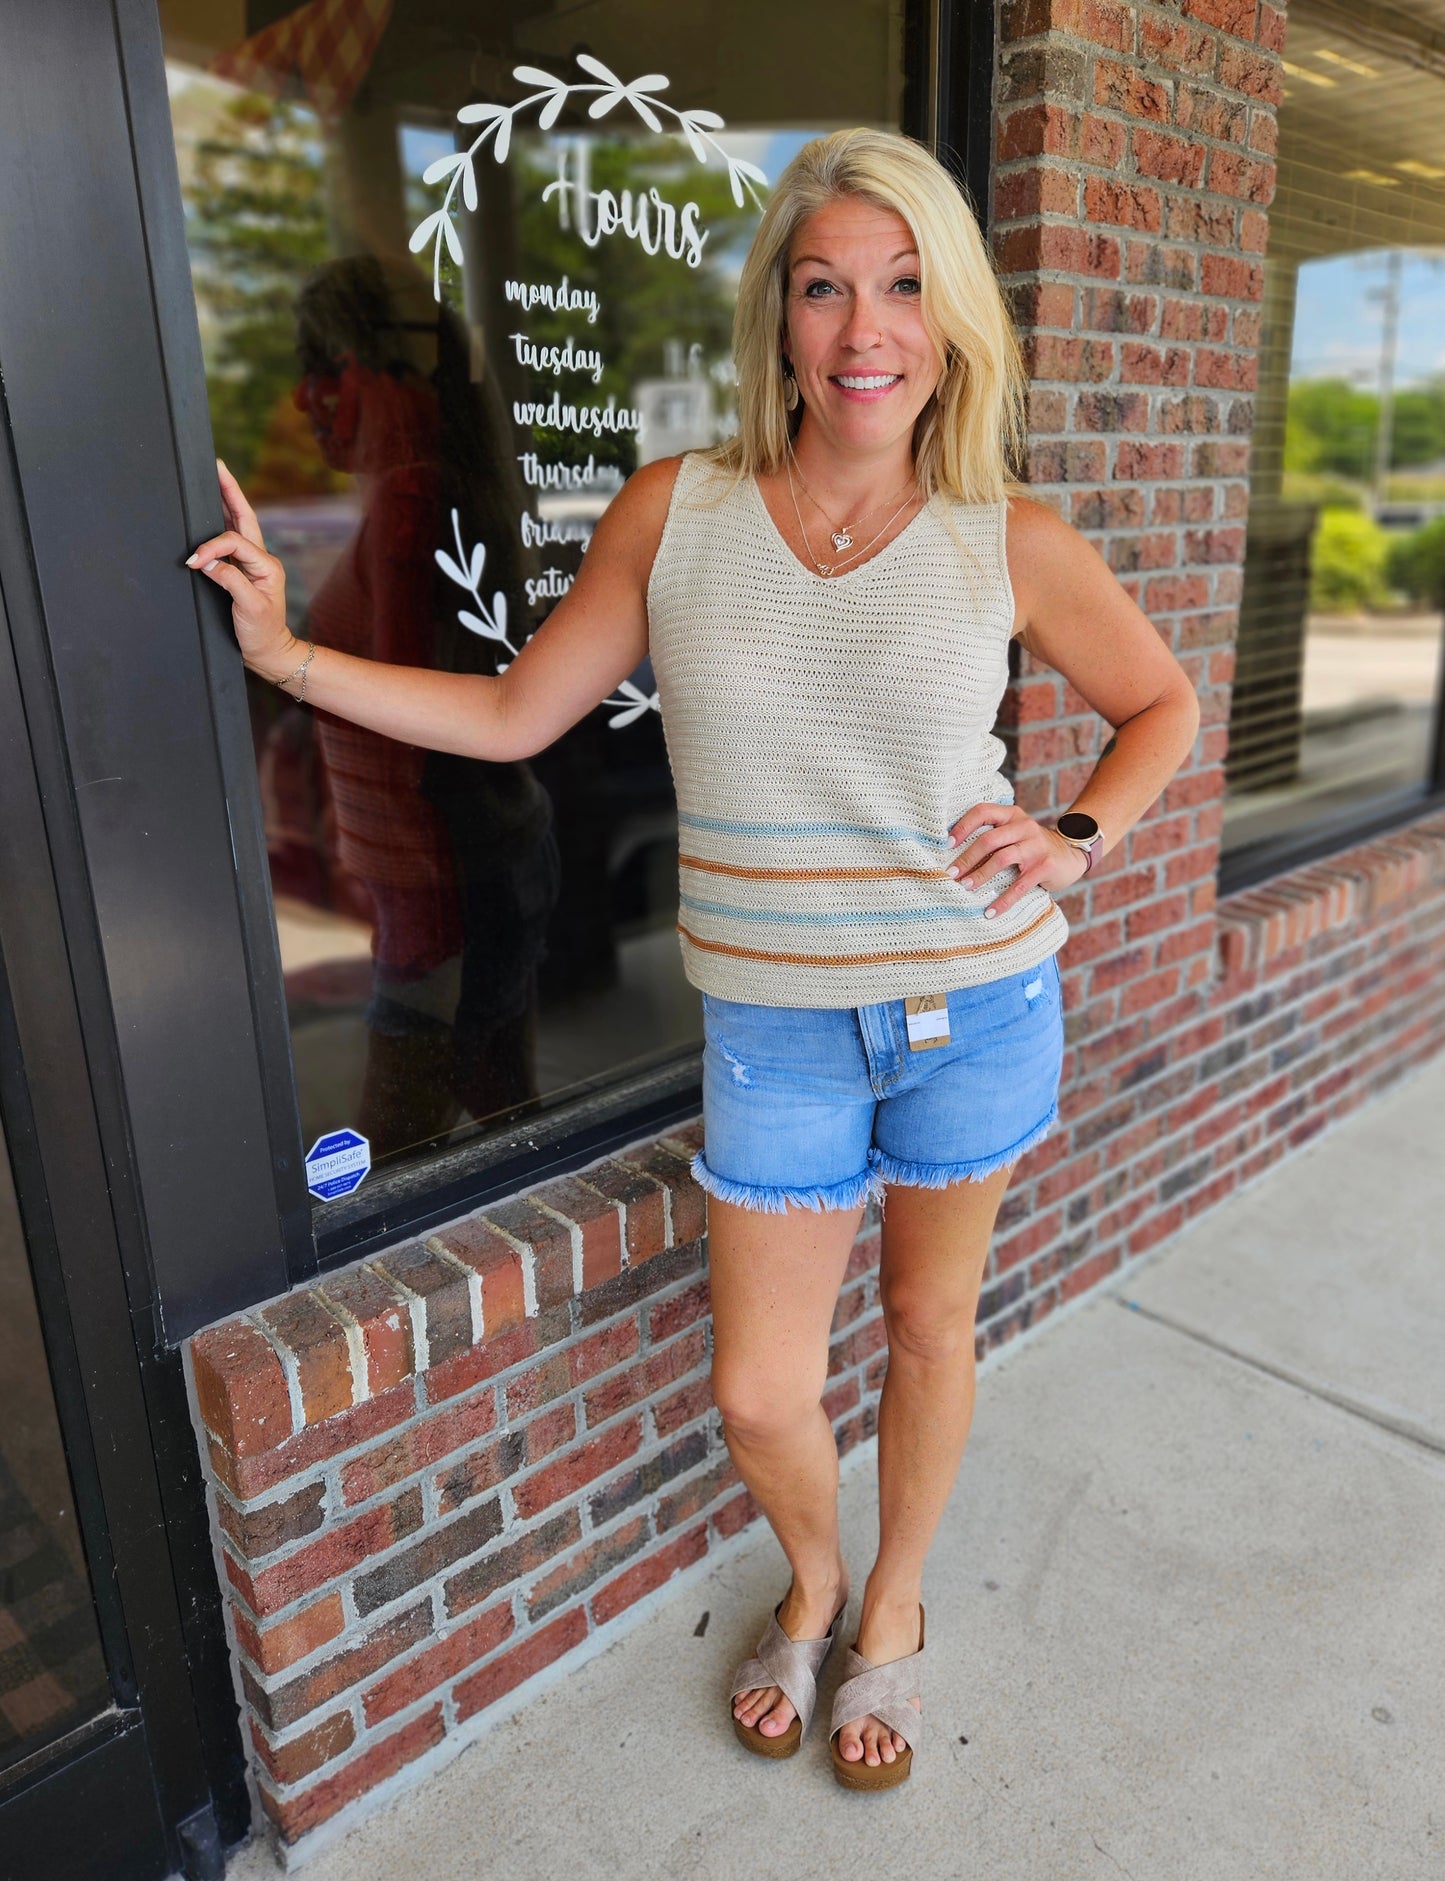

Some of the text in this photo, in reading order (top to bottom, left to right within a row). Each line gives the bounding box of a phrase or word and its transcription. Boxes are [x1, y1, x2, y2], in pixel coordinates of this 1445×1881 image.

[543, 145, 709, 268] Hours
[505, 276, 600, 324] monday
[508, 334, 604, 384] tuesday
[513, 391, 644, 443] wednesday
[517, 452, 625, 491] thursda
[320, 1141, 344, 1153] Protected
